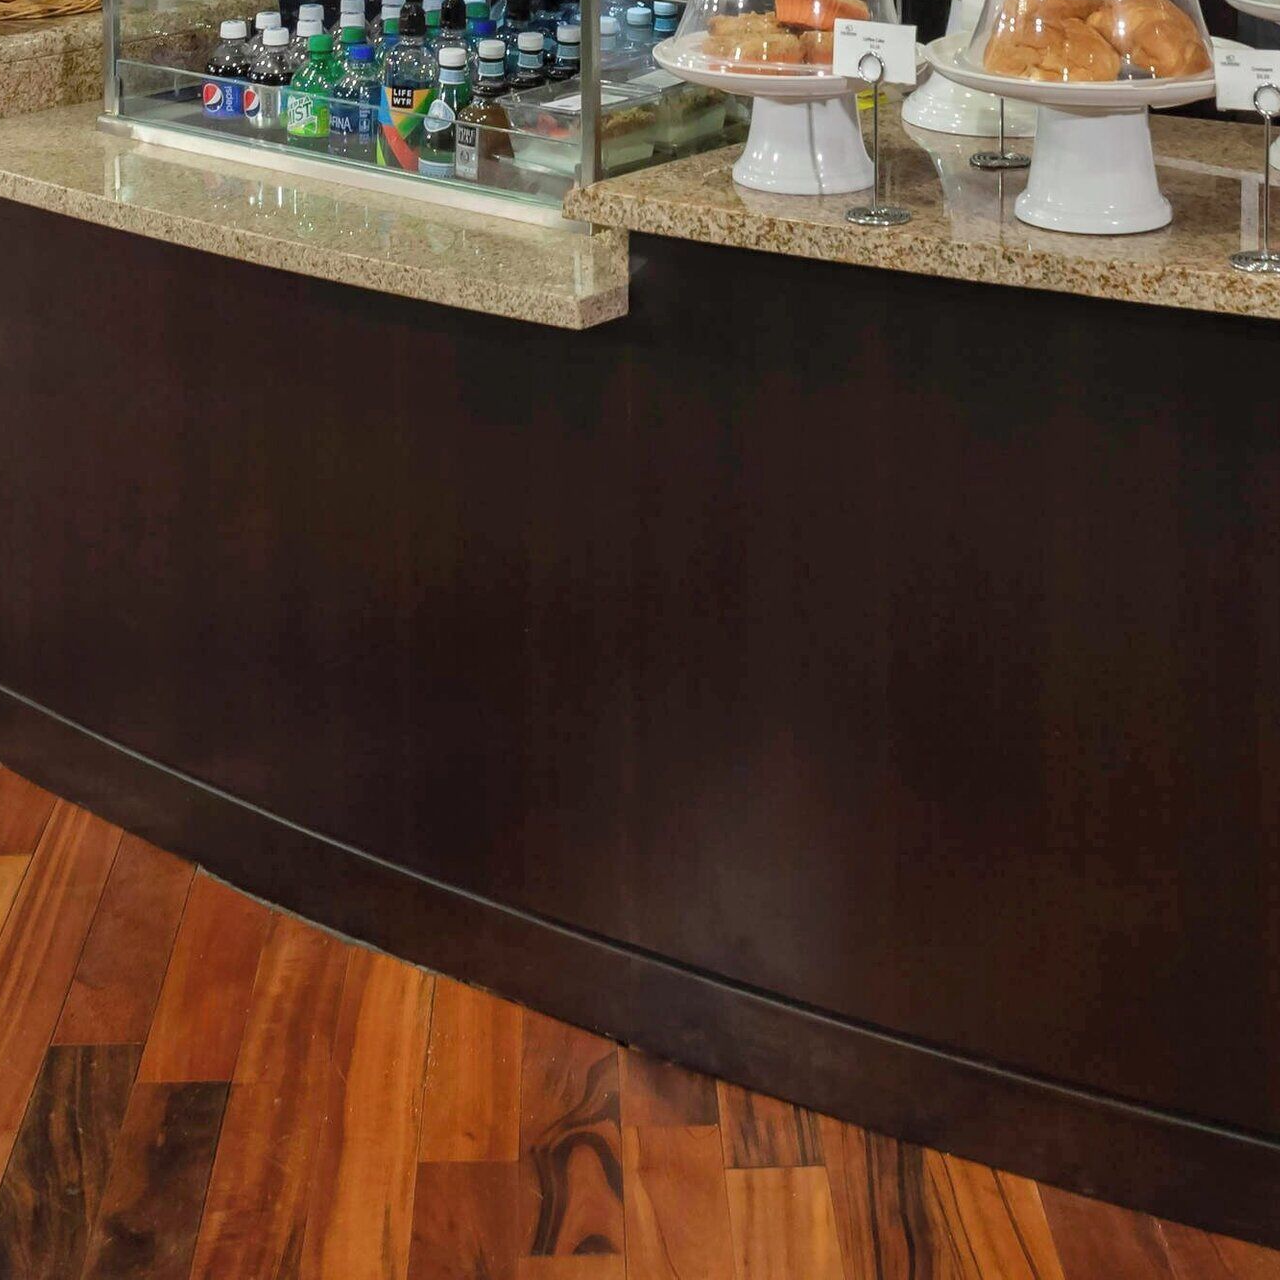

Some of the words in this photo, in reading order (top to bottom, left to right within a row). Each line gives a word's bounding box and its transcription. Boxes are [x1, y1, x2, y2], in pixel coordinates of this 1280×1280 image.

[393, 88, 412, 97] LIFE
[224, 86, 234, 112] pepsi
[393, 97, 412, 106] WTR
